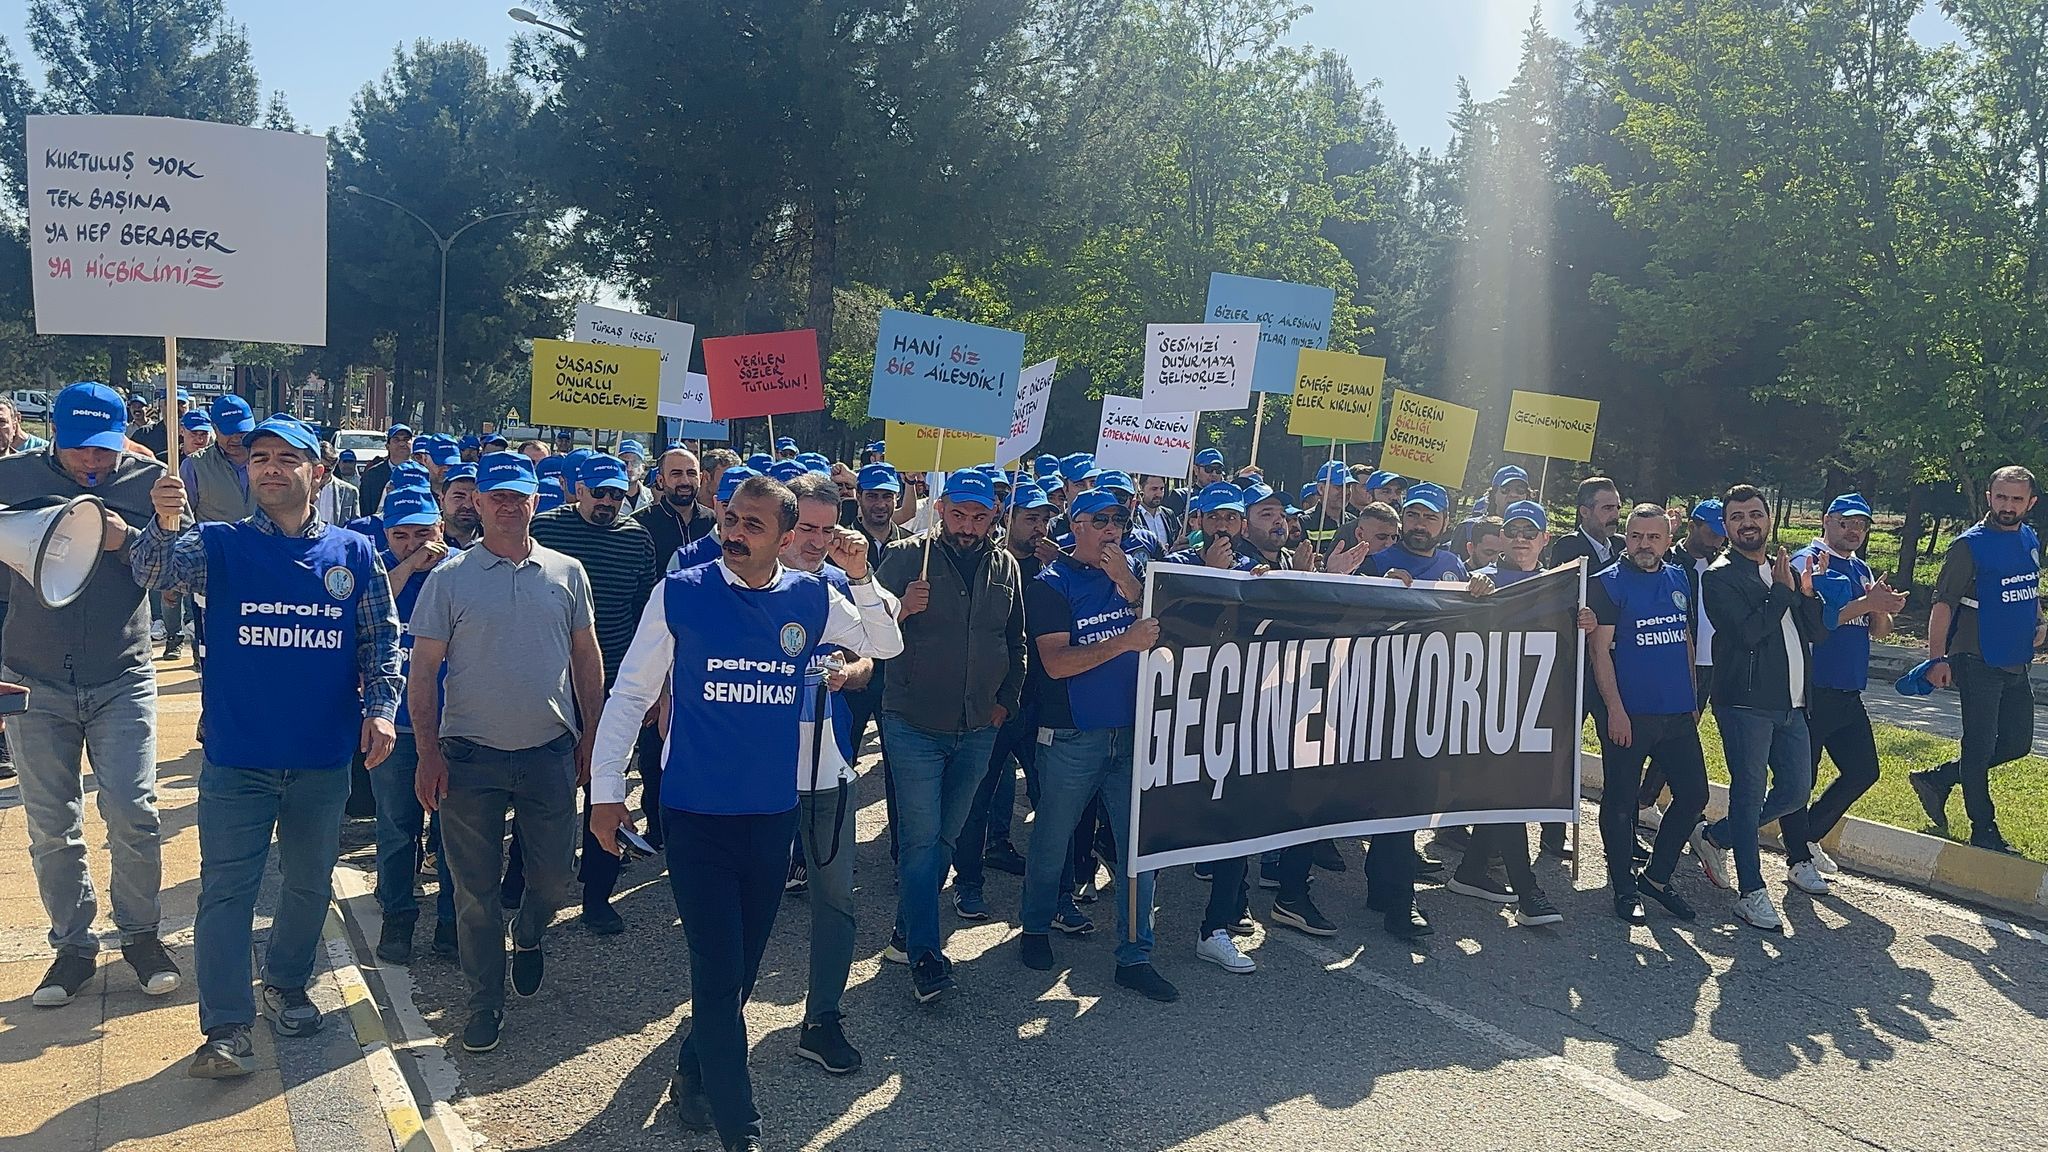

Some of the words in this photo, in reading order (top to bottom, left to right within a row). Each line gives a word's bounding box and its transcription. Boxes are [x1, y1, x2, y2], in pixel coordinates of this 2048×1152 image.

[45, 148, 135, 180] KURTULUŞ
[148, 156, 205, 179] YOK
[46, 188, 84, 209] TEK
[87, 187, 171, 215] BAŞINA
[44, 222, 69, 244] YA
[76, 222, 111, 243] HEP
[119, 223, 238, 254] BERABER
[48, 256, 72, 279] YA
[86, 253, 225, 289] HİÇBİRİMİZ
[1213, 304, 1250, 321] BİZLER
[1256, 312, 1274, 328] KOÇ
[1278, 313, 1322, 332] AİLESİNİN
[591, 320, 624, 339] TÜPRAŞ
[893, 334, 943, 358] HANİ
[949, 344, 981, 366] BİZ
[1159, 335, 1220, 353] SESİMİZİ
[555, 355, 619, 376] YAŞASIN
[734, 351, 786, 367] VERİLEN
[884, 356, 915, 377] BİR
[1161, 354, 1235, 369] DUYURMAYA
[556, 372, 612, 391] ONURLU
[739, 364, 784, 380] SÖZLER
[549, 388, 649, 410] MÜCADELEMİZ
[1337, 382, 1374, 397] UZANAN
[1296, 393, 1325, 410] ELLER
[1399, 394, 1445, 422] İŞÇİLERİN
[1105, 411, 1140, 428] ZAFER
[1144, 416, 1189, 433] DİRENEN
[1153, 435, 1192, 450] OLACAK
[1390, 427, 1448, 452] SERMAYEYİ
[1388, 443, 1435, 464] YENECEK
[240, 601, 343, 620] petrol-iş
[238, 623, 343, 649] SENDİKASI
[707, 658, 796, 677] petrol-iş
[703, 679, 797, 705] SENDİKASI
[1139, 619, 1557, 800] GEÇİNEMİYORUZ
